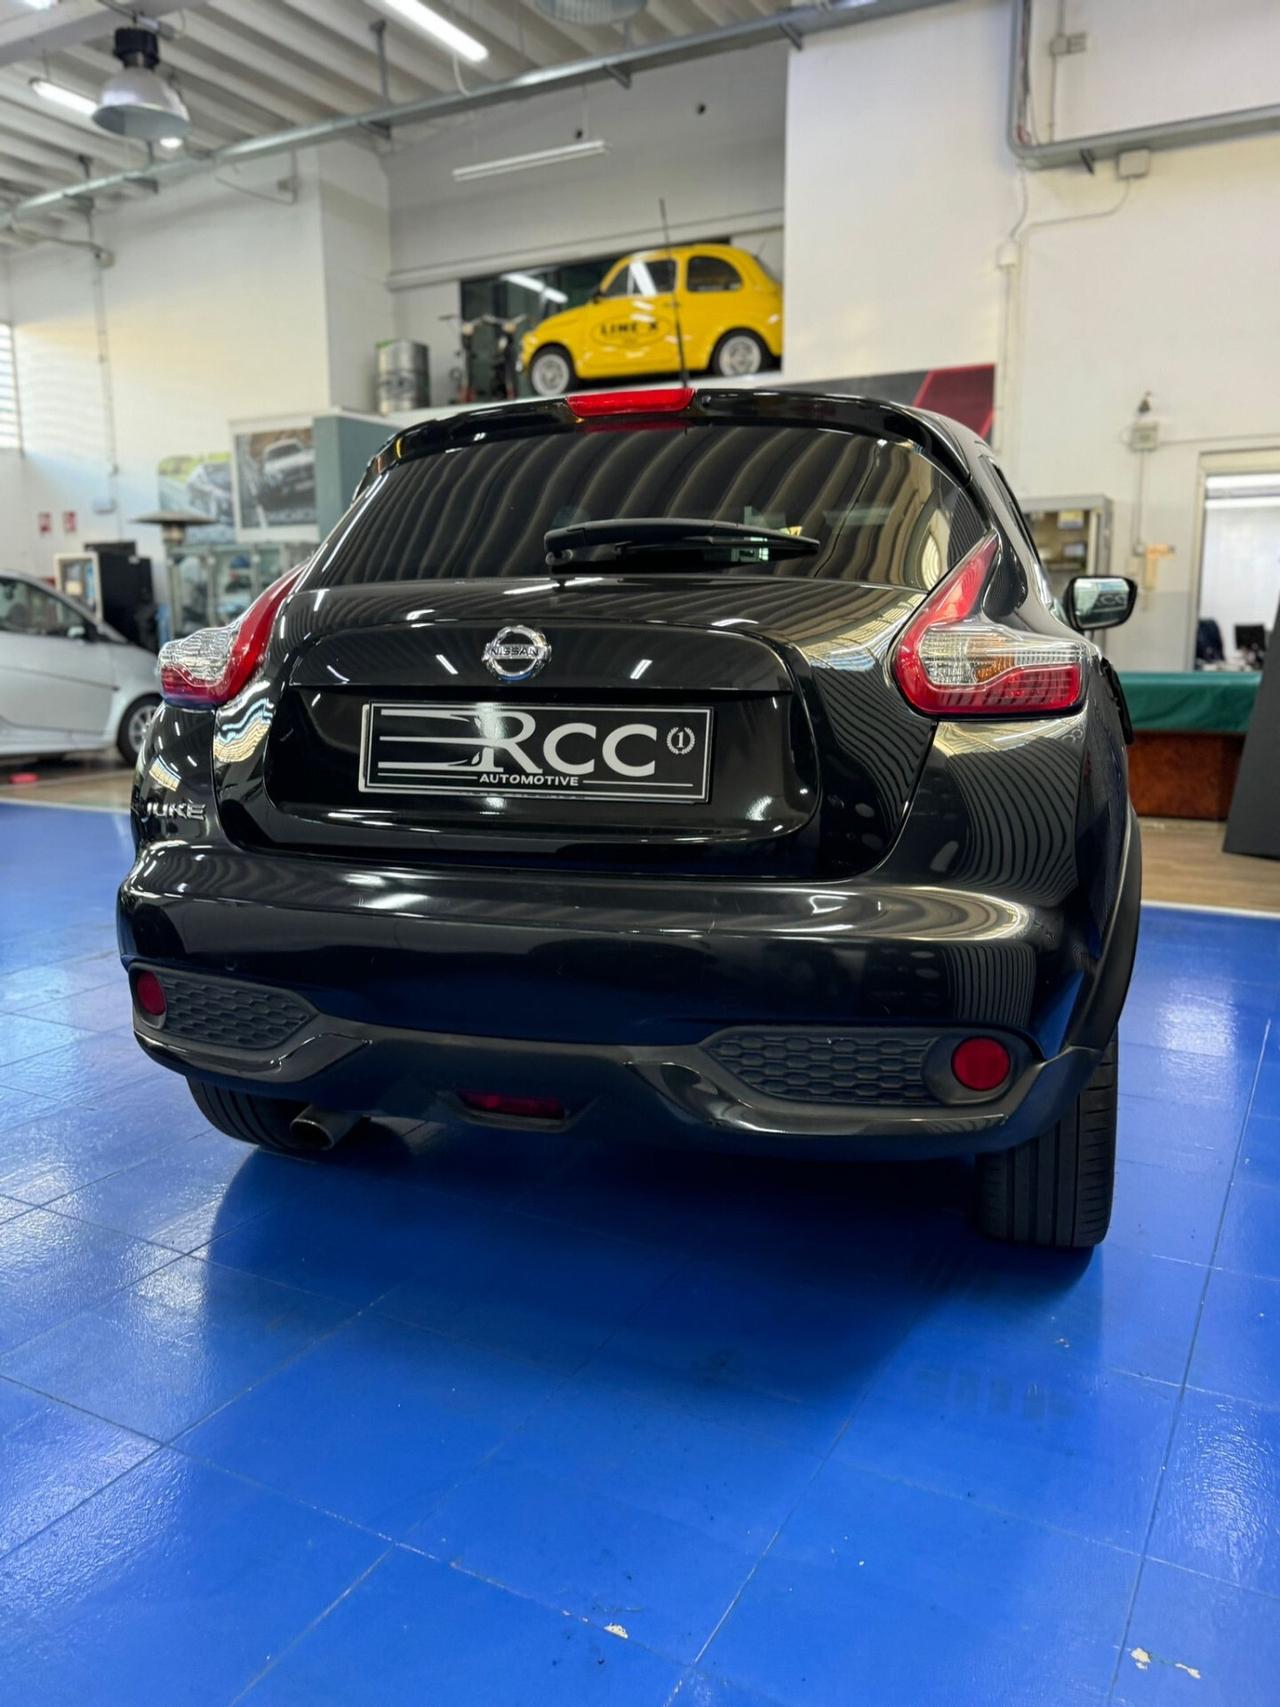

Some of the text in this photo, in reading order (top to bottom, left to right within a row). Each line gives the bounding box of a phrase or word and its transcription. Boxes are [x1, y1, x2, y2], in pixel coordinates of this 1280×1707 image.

[489, 645, 540, 657] NISSAN
[478, 773, 580, 788] AUTOMOTIVE
[143, 799, 206, 822] JUKE
